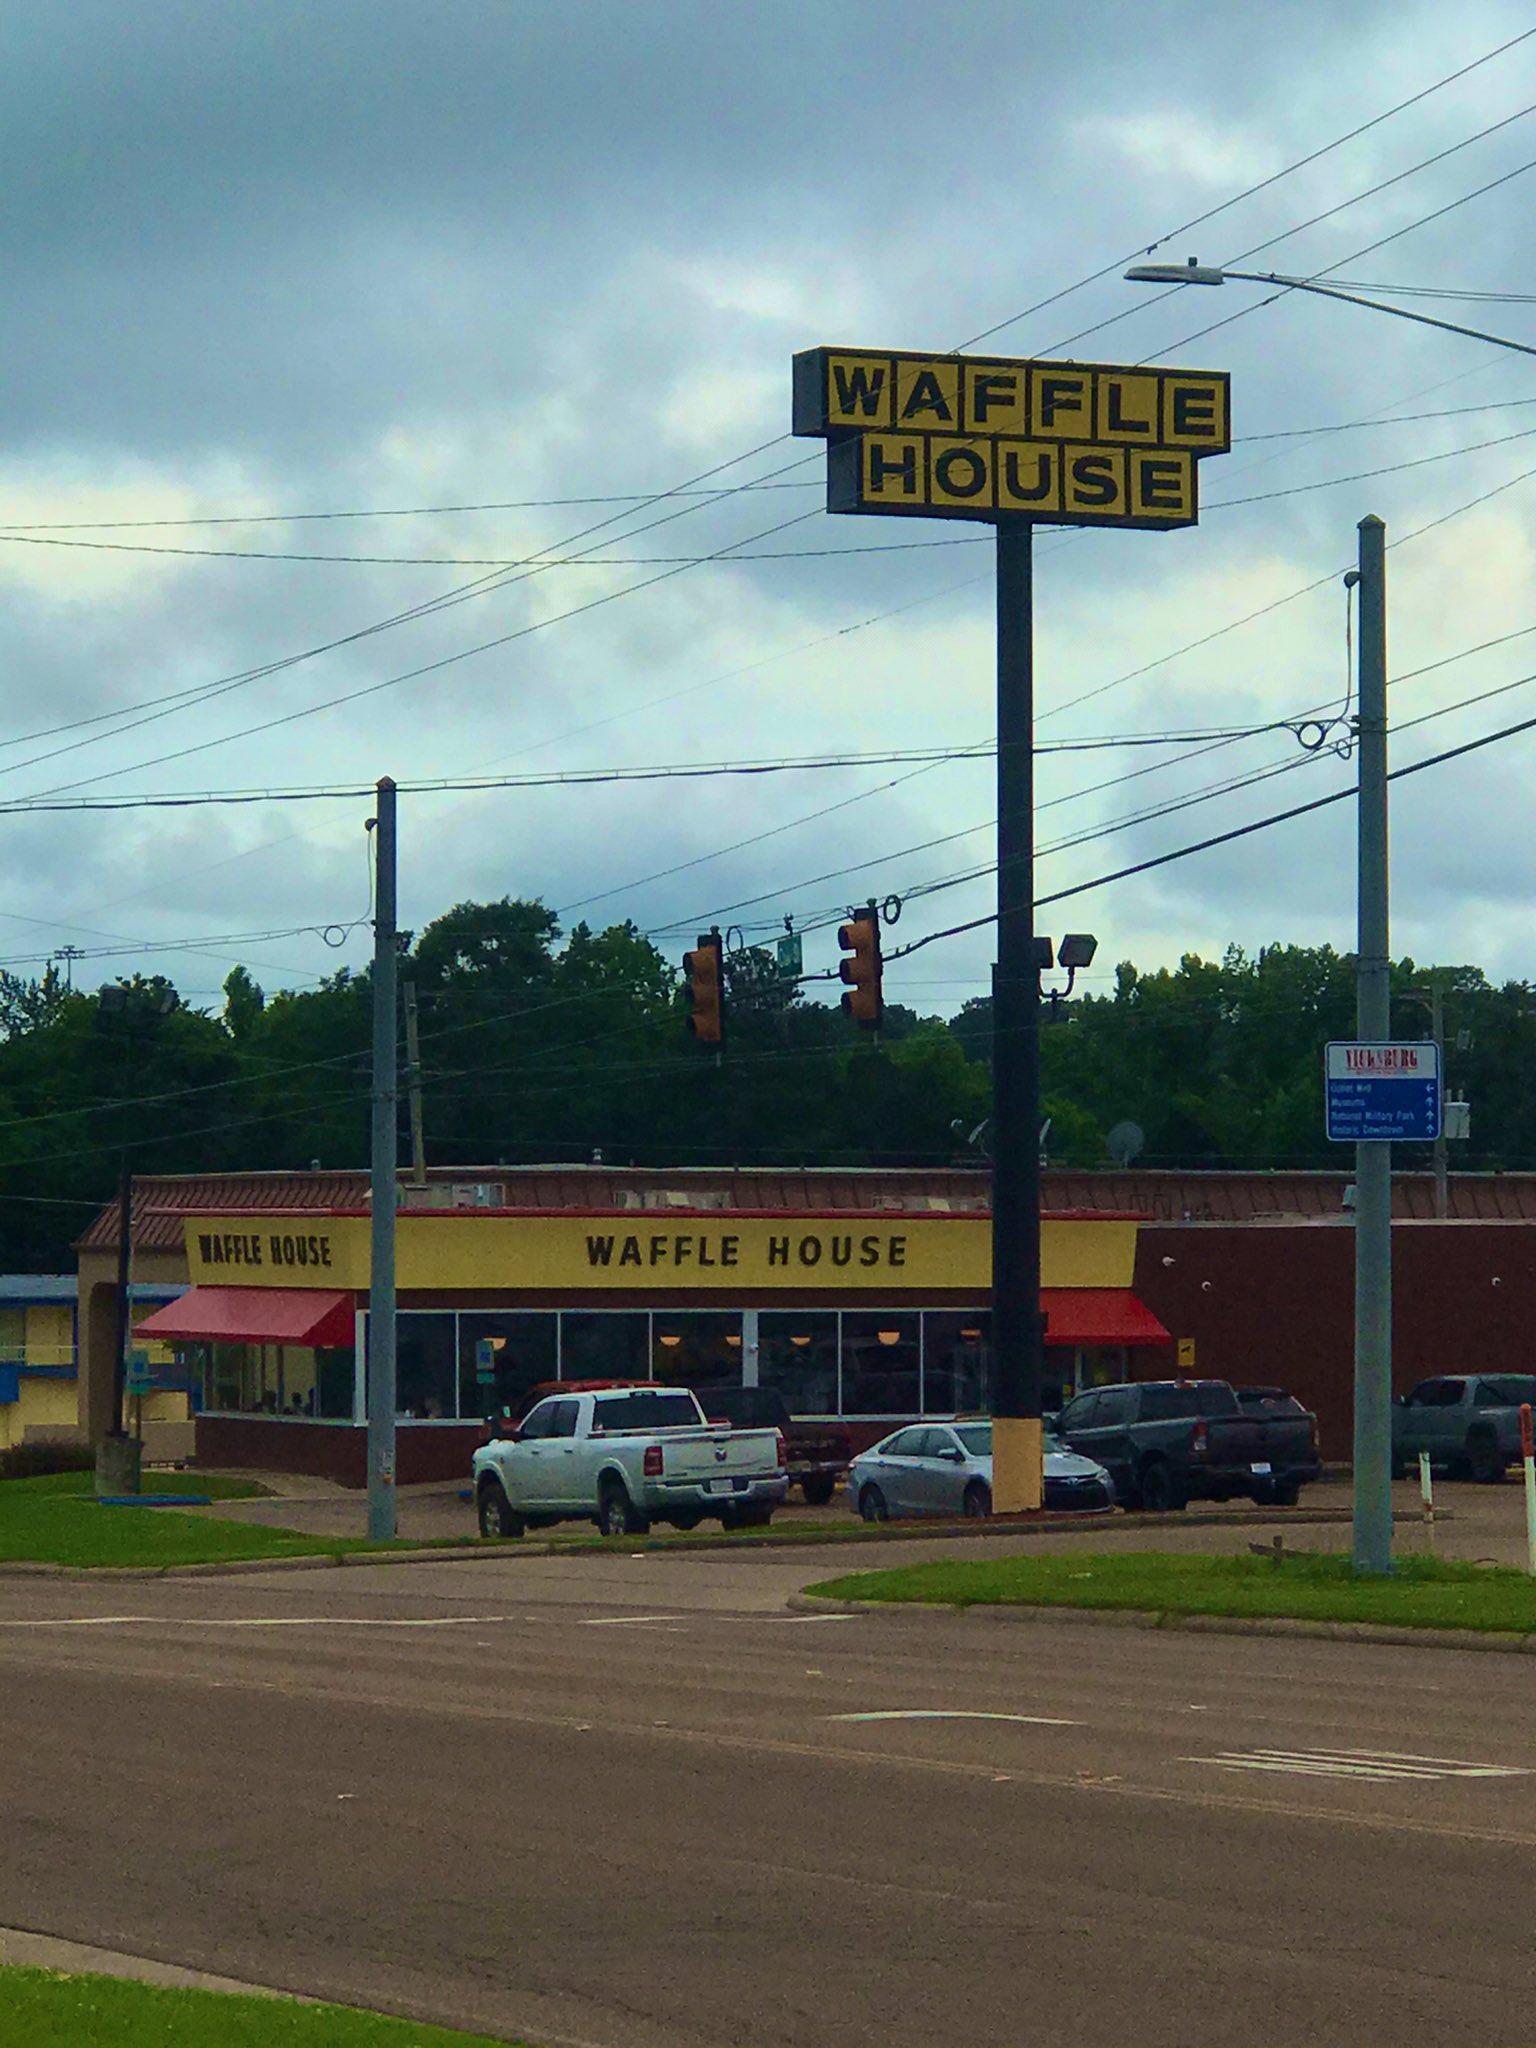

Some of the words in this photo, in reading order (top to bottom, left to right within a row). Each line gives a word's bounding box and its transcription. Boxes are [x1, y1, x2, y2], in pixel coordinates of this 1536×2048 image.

[833, 365, 1217, 436] WAFFLE
[869, 443, 1184, 509] HOUSE
[1345, 1049, 1418, 1067] VICKSBURG
[198, 1234, 262, 1264] WAFFLE
[269, 1235, 332, 1266] HOUSE
[585, 1235, 740, 1266] WAFFLE
[767, 1235, 907, 1267] HOUSE
